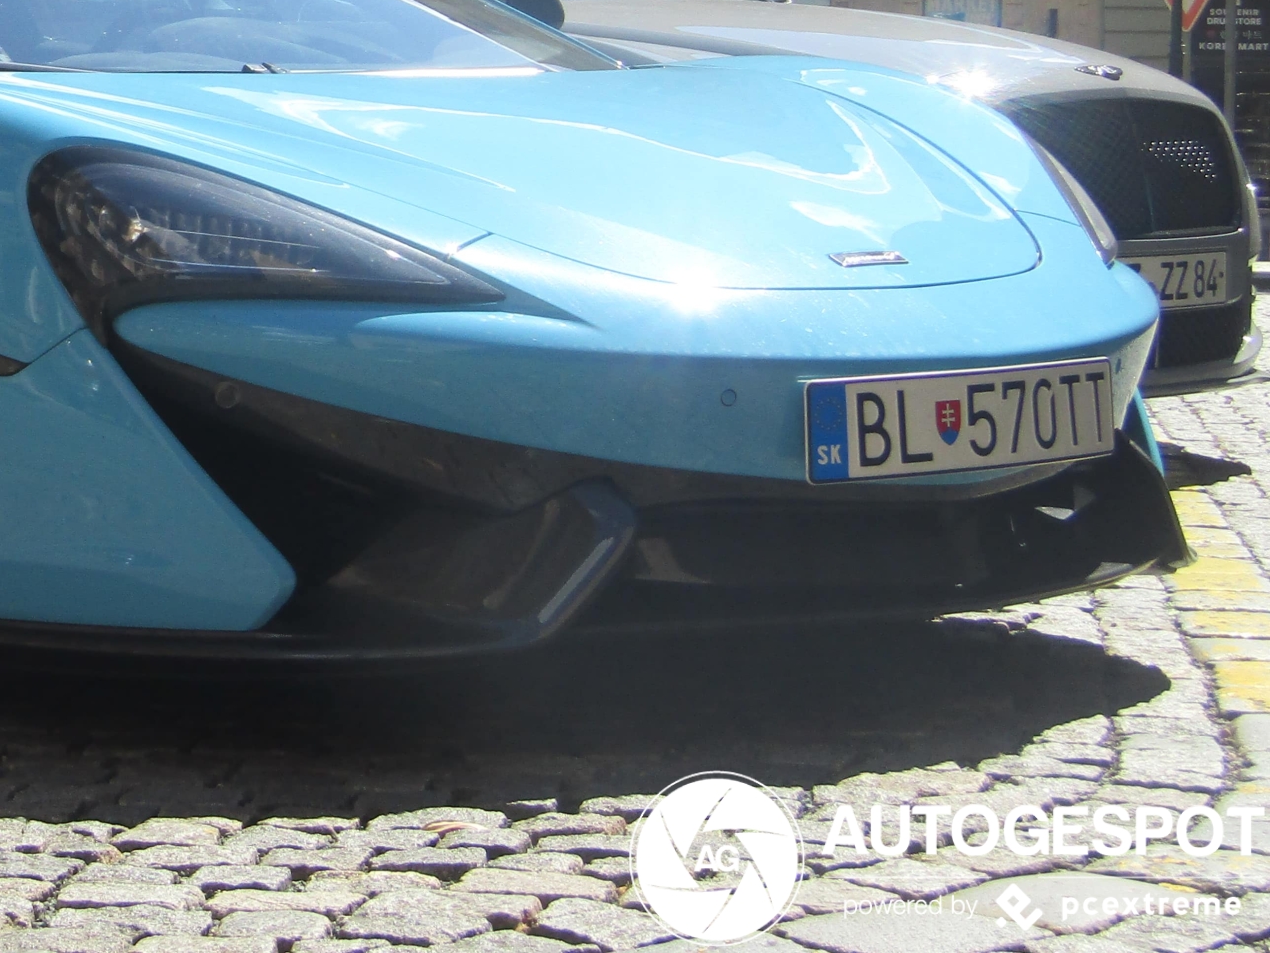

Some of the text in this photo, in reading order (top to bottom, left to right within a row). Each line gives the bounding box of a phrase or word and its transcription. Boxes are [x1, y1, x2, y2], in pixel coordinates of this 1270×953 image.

[1206, 17, 1262, 25] DRUTORE
[1237, 42, 1269, 50] MART
[856, 371, 1105, 467] BL 570TT
[817, 444, 841, 465] SK
